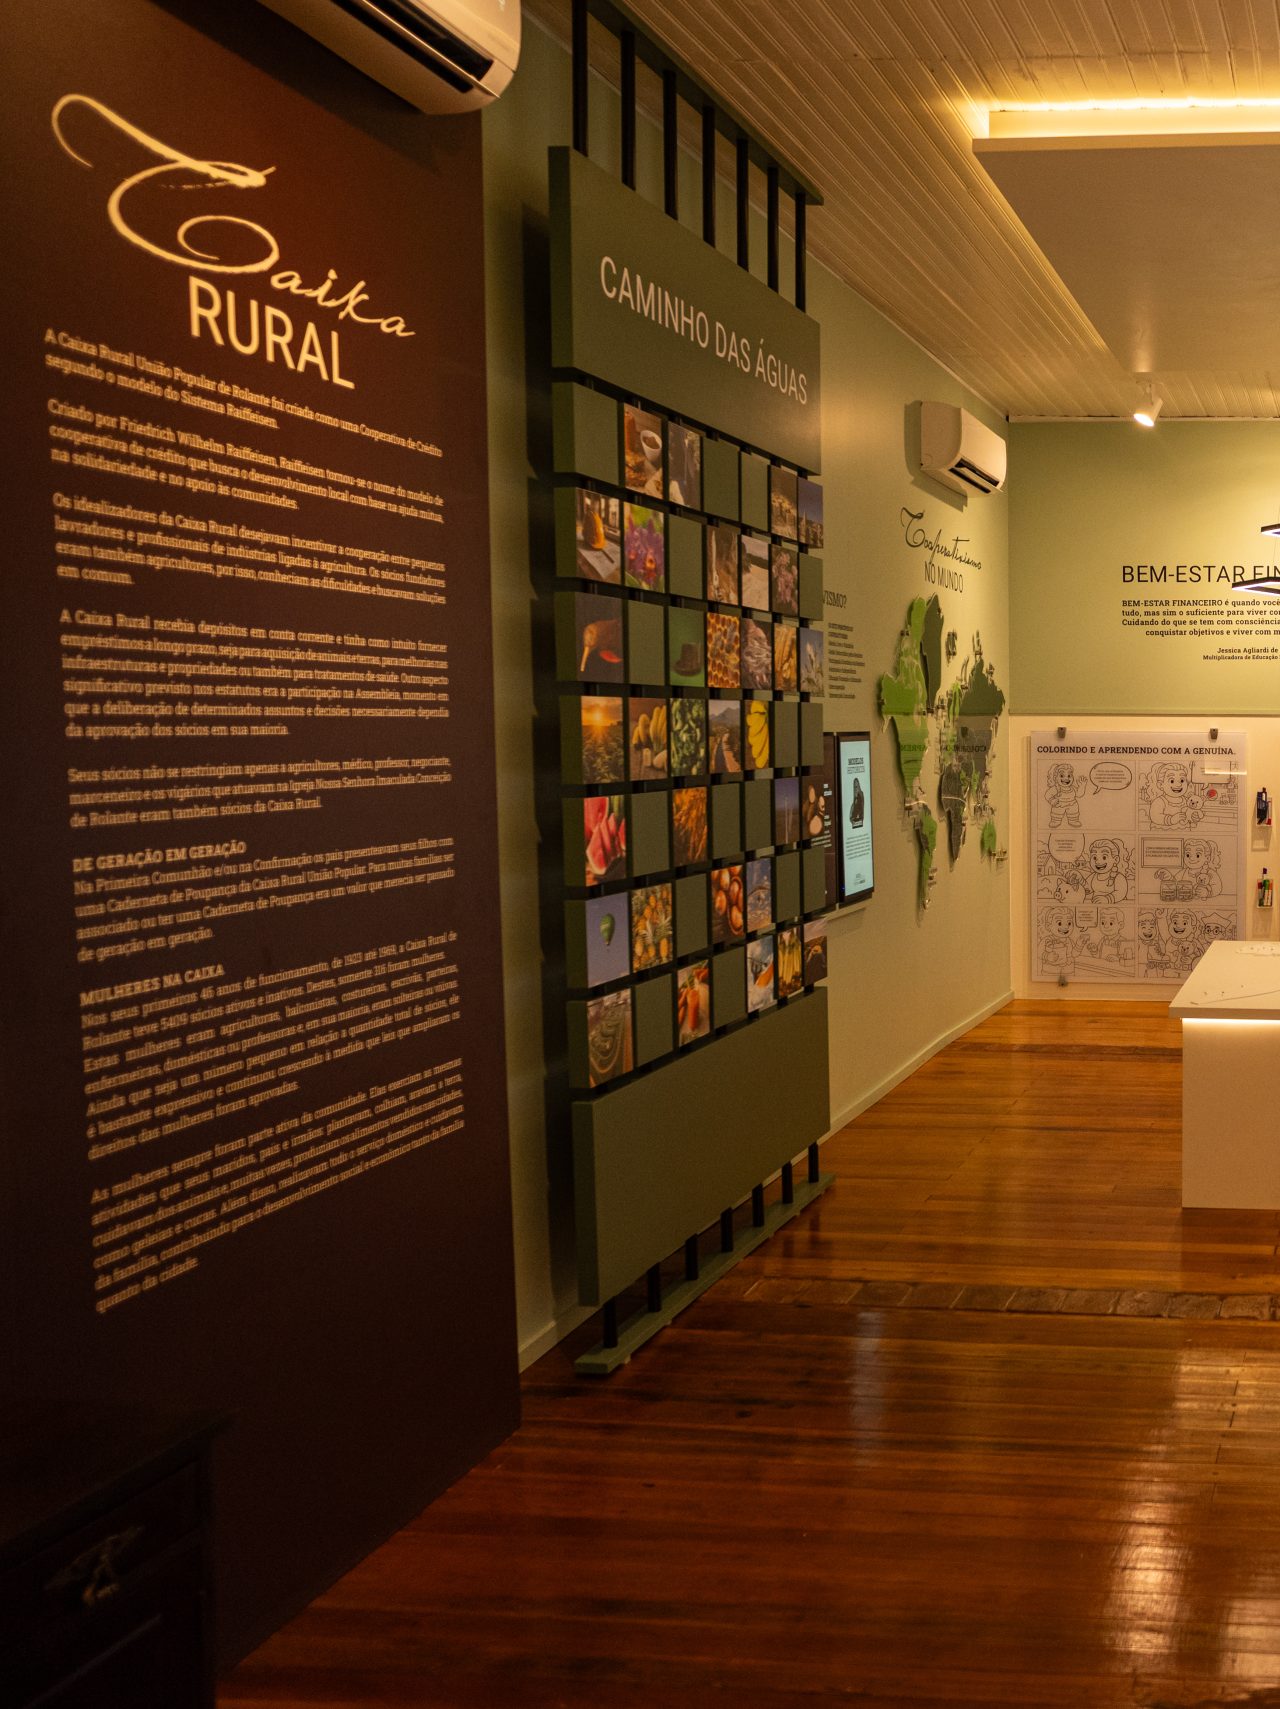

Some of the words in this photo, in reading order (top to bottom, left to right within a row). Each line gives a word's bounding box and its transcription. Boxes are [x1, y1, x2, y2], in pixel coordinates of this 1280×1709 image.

[189, 276, 355, 389] RURAL
[600, 256, 709, 348] CAMINHO
[715, 321, 750, 373] DAS
[755, 338, 807, 405] ÁGUAS
[924, 560, 936, 584] NO
[938, 565, 964, 593] MUNDO
[1122, 565, 1245, 583] BEM-ESTAR
[1172, 599, 1223, 607] FINANCEIRO
[1231, 598, 1261, 608] quando
[1262, 598, 1280, 606] você
[1122, 609, 1142, 618] tudo,
[1186, 608, 1224, 616] suficiente
[1246, 608, 1267, 616] viver
[1122, 618, 1159, 626] Cuidando
[1161, 618, 1171, 626] do
[1145, 628, 1187, 637] conquistar
[1188, 628, 1224, 637] objetivos
[1232, 628, 1253, 636] viver
[1037, 746, 1088, 754] COLORINDO
[1098, 746, 1159, 754] APRENDENDO
[79, 976, 161, 1007] MULHERES
[162, 972, 182, 988] NA
[183, 963, 225, 983] CAIXA
